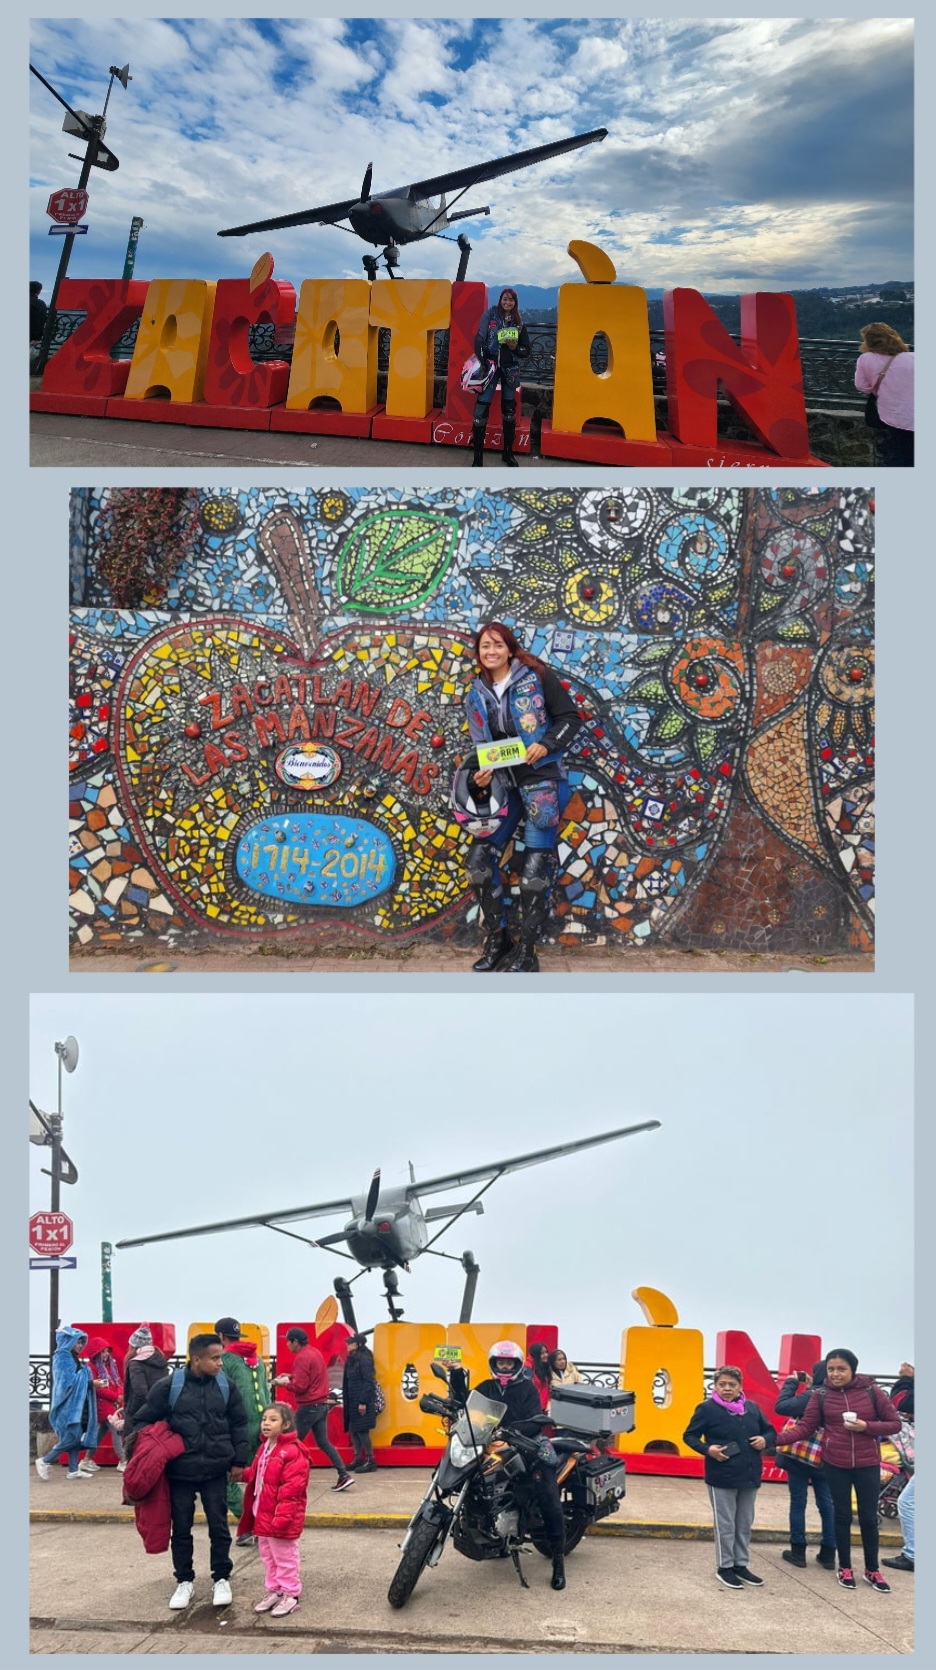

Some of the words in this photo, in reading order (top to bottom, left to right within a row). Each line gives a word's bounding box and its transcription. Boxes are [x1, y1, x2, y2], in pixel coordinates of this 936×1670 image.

[61, 191, 84, 199] ALTO
[54, 198, 85, 213] 1x1
[199, 673, 381, 730] ZACATLAN
[385, 698, 432, 742] DE
[180, 731, 250, 787] LAS
[253, 704, 439, 796] MANZANAS
[500, 746, 520, 758] RRM
[251, 842, 387, 883] 1714-2014
[36, 1215, 65, 1225] ALTO
[31, 1224, 69, 1241] 1x1
